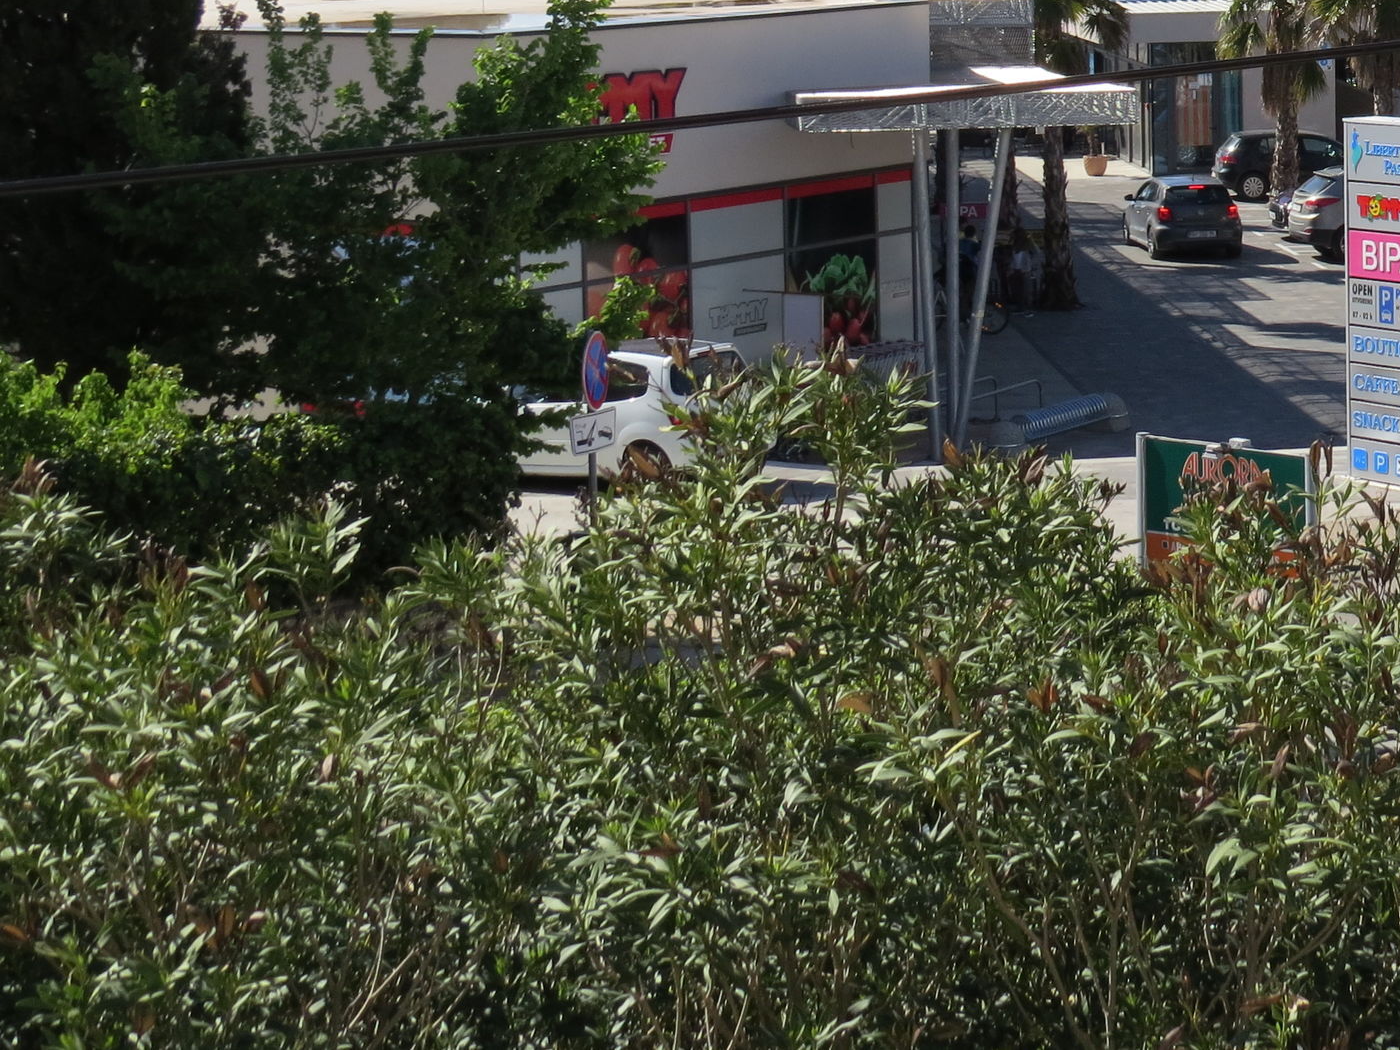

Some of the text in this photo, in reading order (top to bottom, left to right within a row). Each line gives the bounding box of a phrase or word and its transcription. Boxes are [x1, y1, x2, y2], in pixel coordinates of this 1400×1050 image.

[1352, 283, 1373, 296] OPEN
[1382, 289, 1391, 307] P
[1353, 374, 1400, 396] CAFFE
[1353, 411, 1400, 434] SNACK
[1181, 452, 1263, 486] AURORA
[1377, 454, 1386, 471] P
